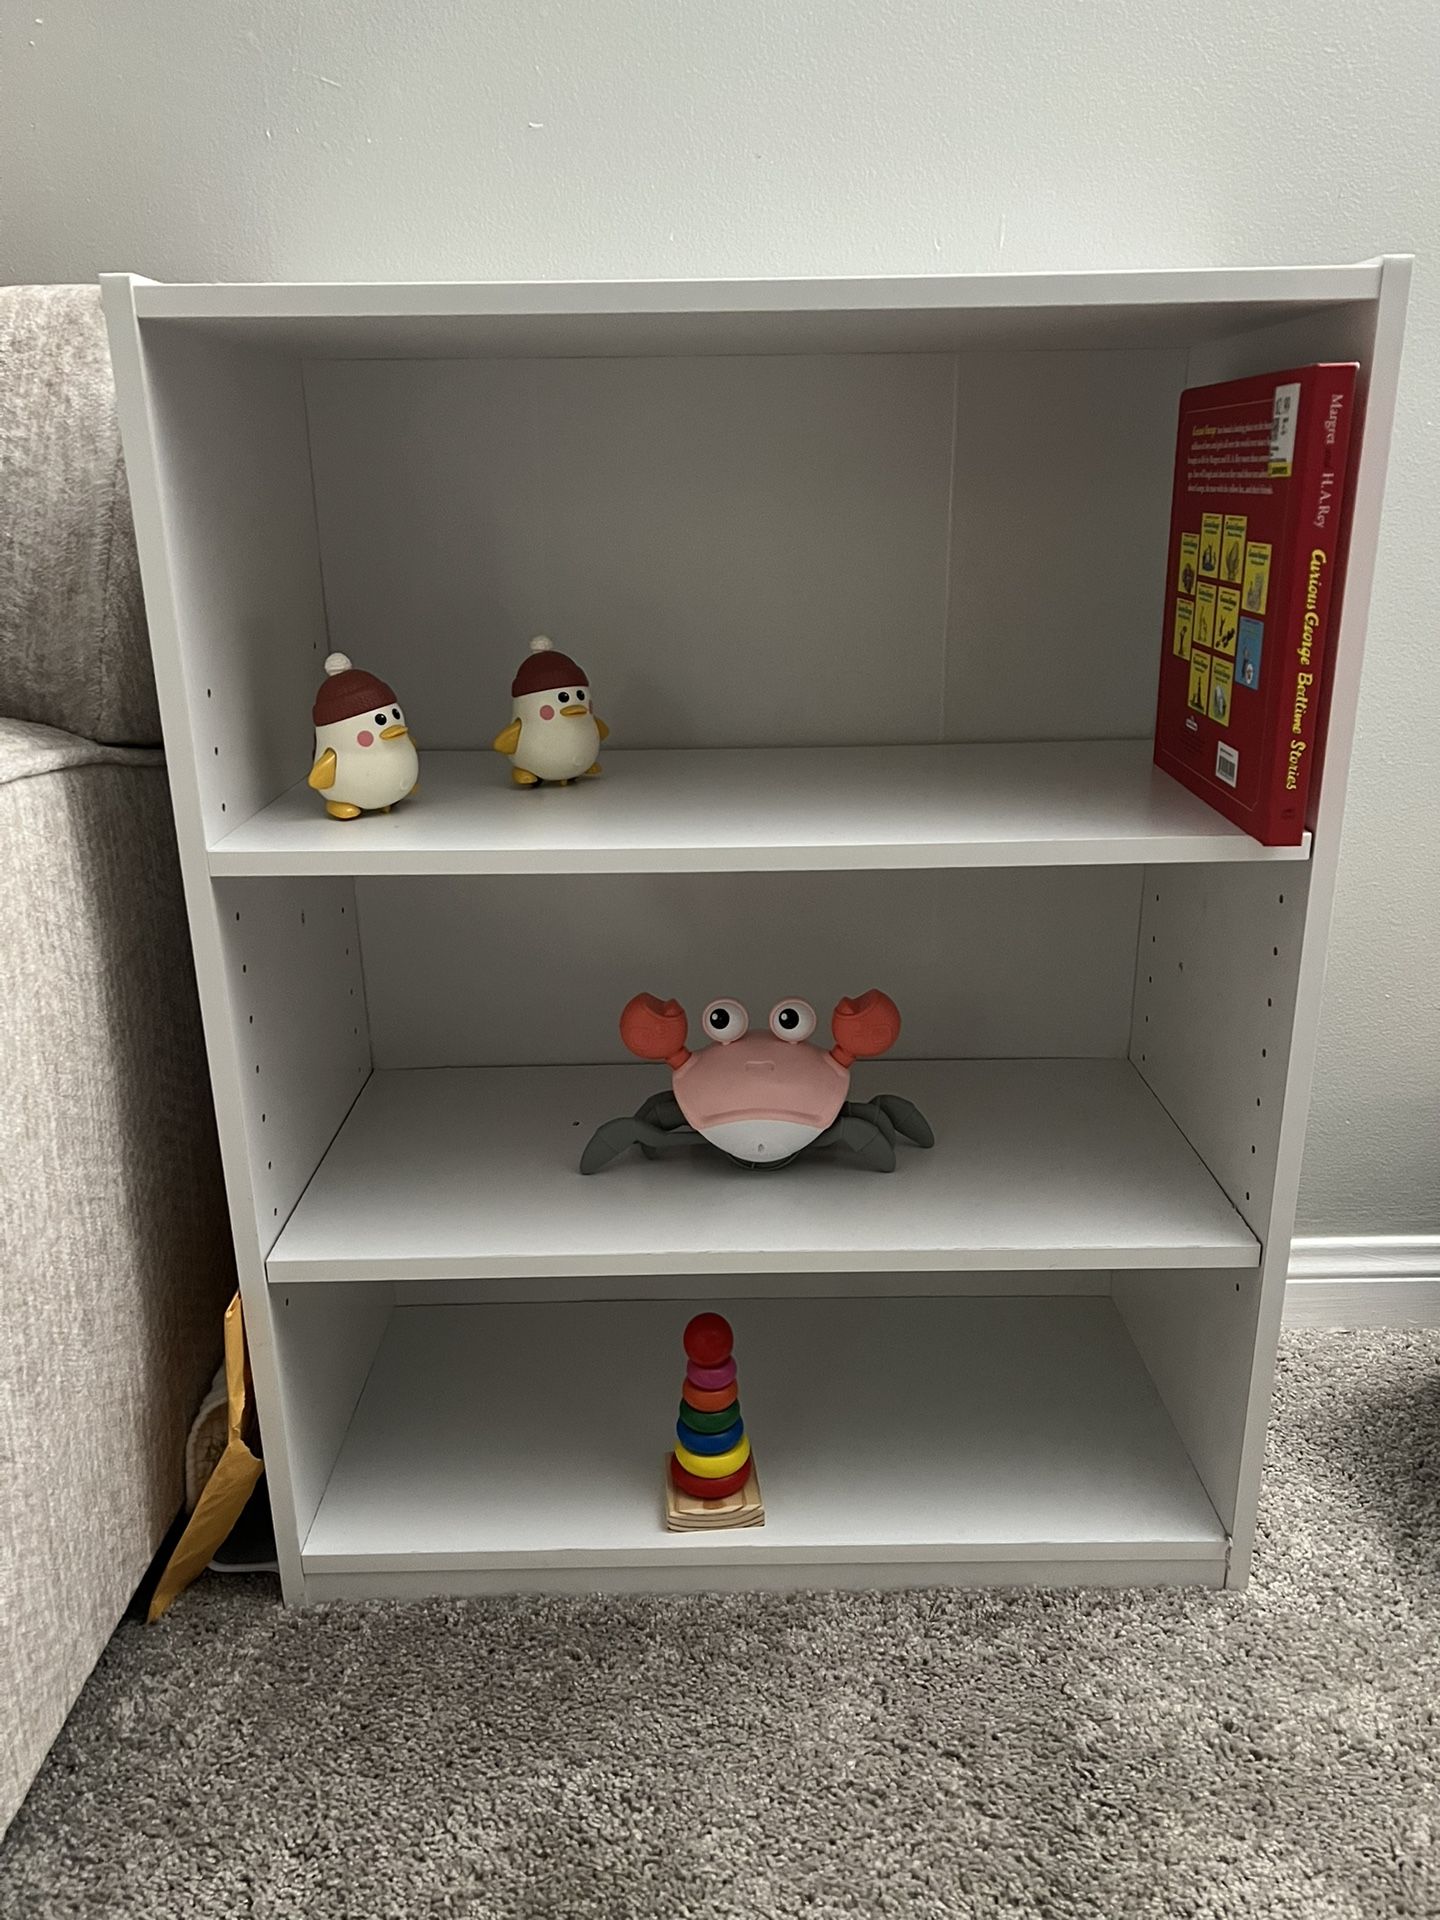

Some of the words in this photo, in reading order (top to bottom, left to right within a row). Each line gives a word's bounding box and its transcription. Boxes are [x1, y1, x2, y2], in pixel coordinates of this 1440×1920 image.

[1324, 394, 1344, 445] Margret
[1306, 549, 1327, 610] Curious
[1296, 611, 1320, 666] George
[1291, 672, 1314, 735] Bedtime
[1285, 739, 1307, 790] Stories
